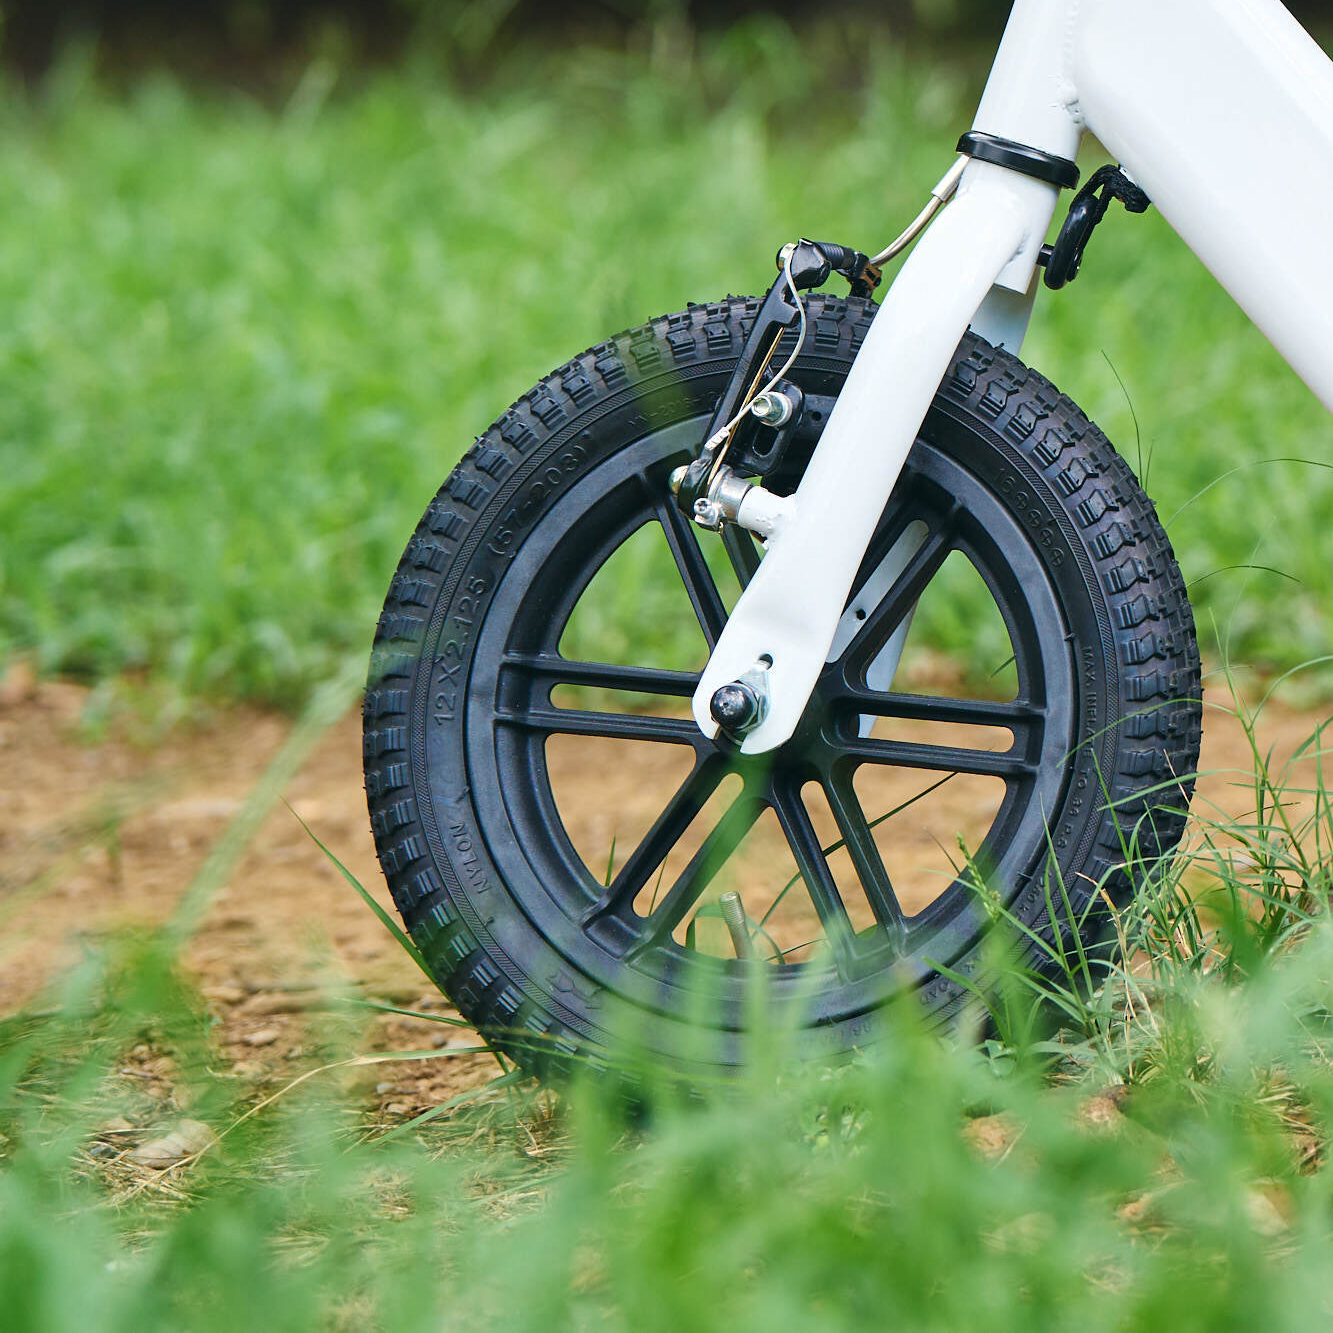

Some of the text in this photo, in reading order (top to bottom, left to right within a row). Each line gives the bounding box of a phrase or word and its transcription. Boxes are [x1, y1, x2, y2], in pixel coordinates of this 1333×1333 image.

[443, 575, 488, 661] 2.125
[433, 692, 458, 726] 12
[449, 823, 492, 894] NYLON
